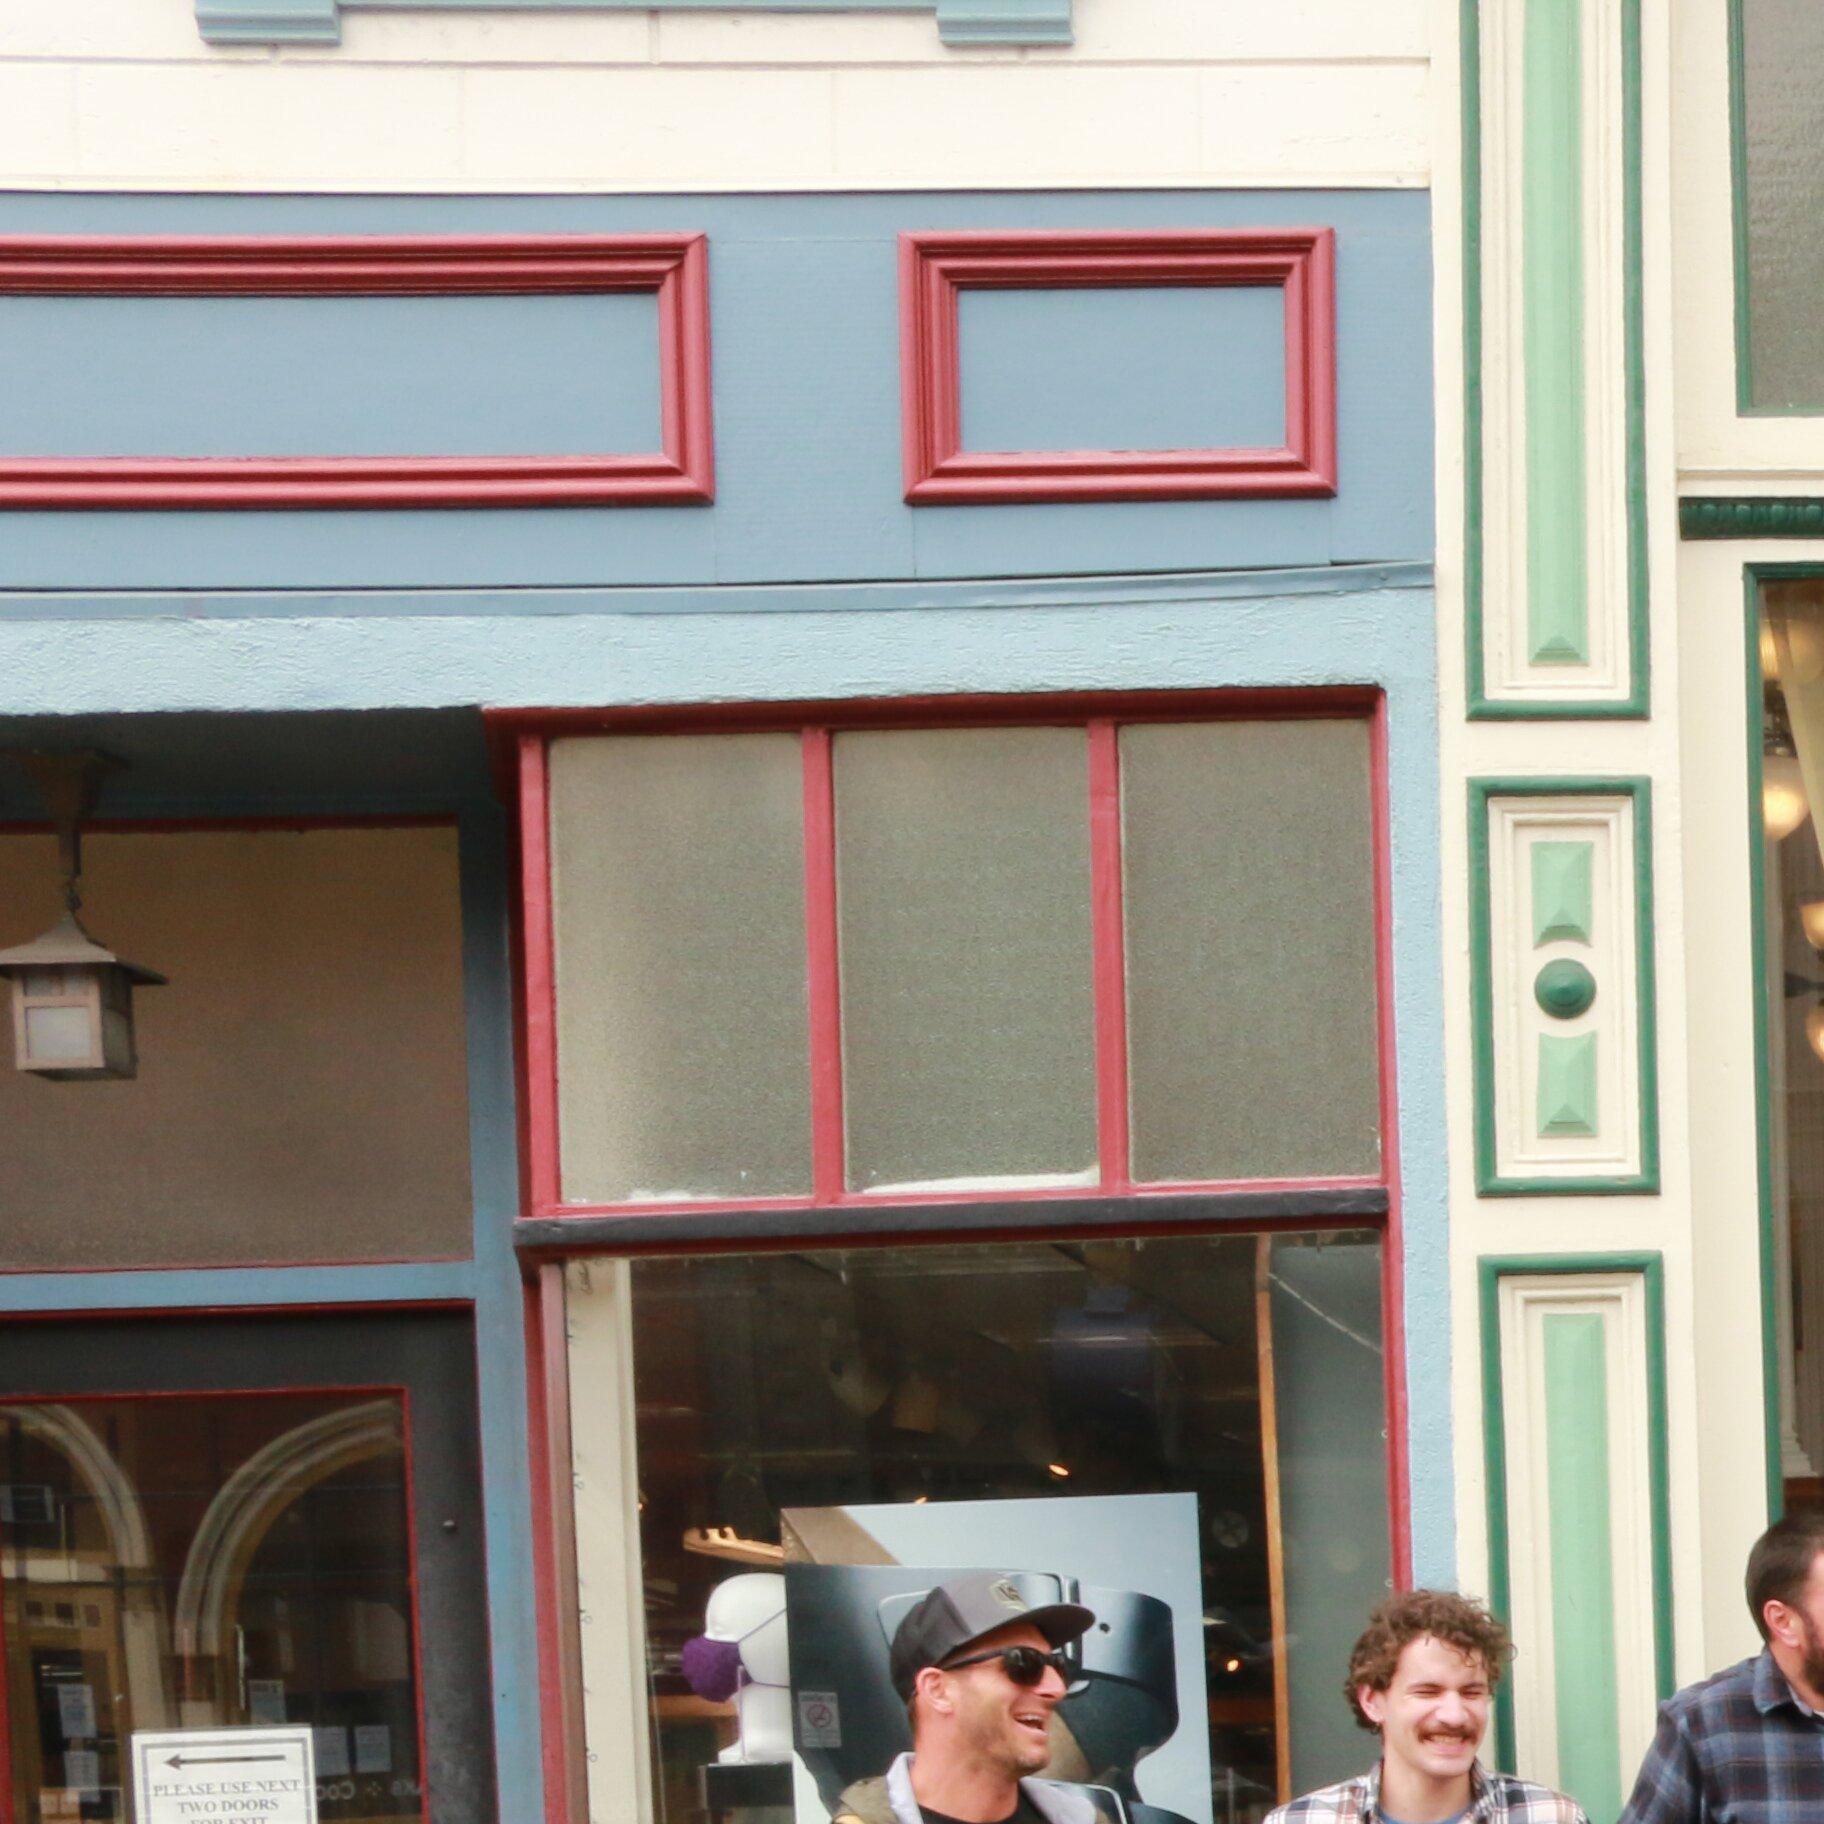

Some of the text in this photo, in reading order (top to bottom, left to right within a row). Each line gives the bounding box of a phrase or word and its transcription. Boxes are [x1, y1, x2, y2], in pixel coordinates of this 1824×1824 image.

[153, 1783, 216, 1798] PLEASE
[220, 1781, 254, 1794] USE
[256, 1779, 301, 1793] NEXT
[177, 1799, 279, 1814] TWO DOORS
